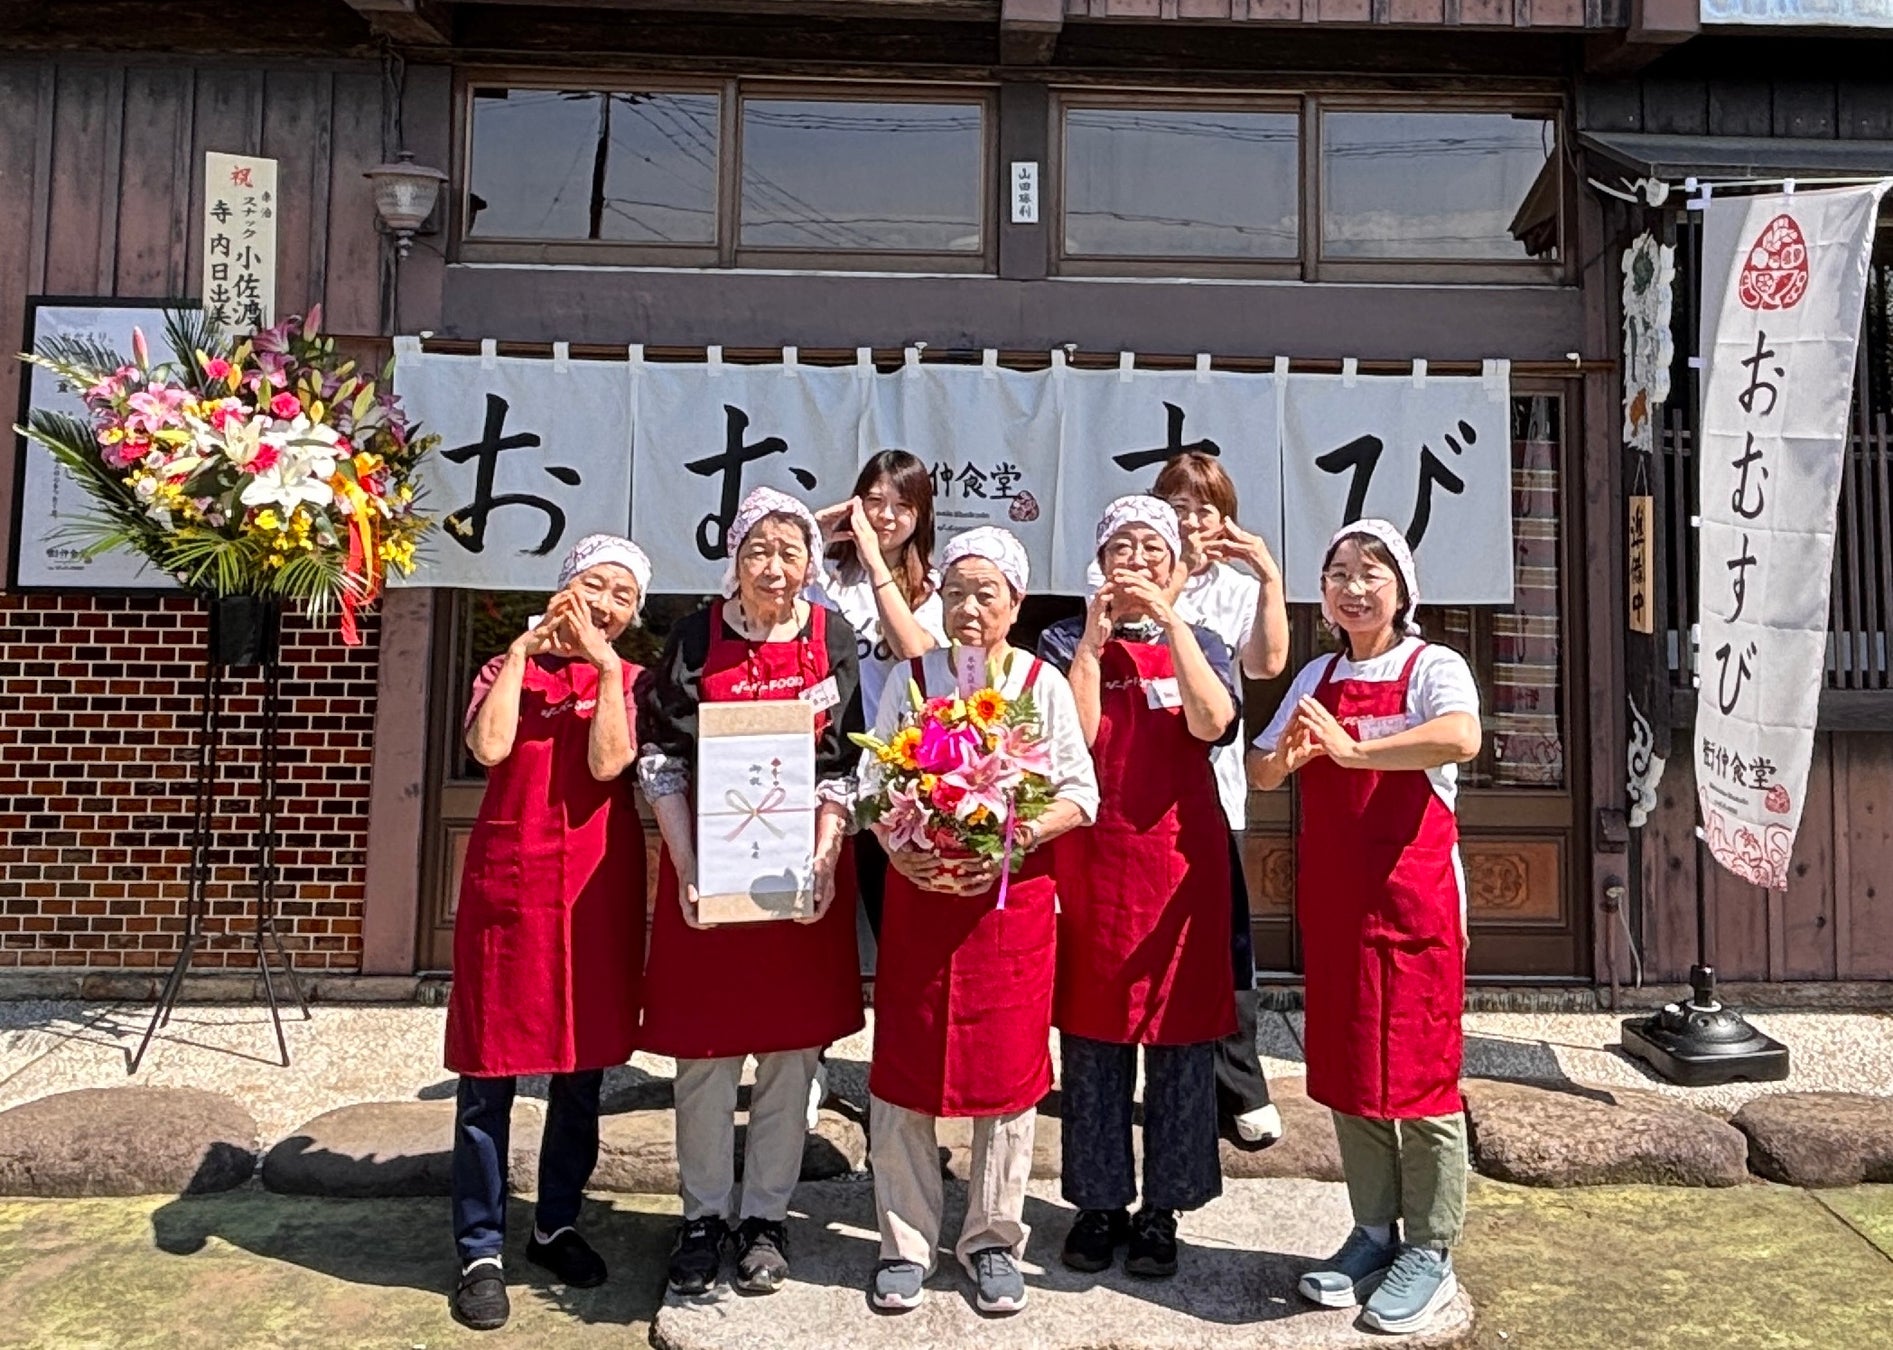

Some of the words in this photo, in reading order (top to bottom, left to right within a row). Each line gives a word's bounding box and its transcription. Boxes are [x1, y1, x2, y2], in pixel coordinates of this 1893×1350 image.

[230, 165, 253, 188] 祝
[209, 199, 233, 326] 寺内日出美
[1716, 331, 1785, 716] おむすび
